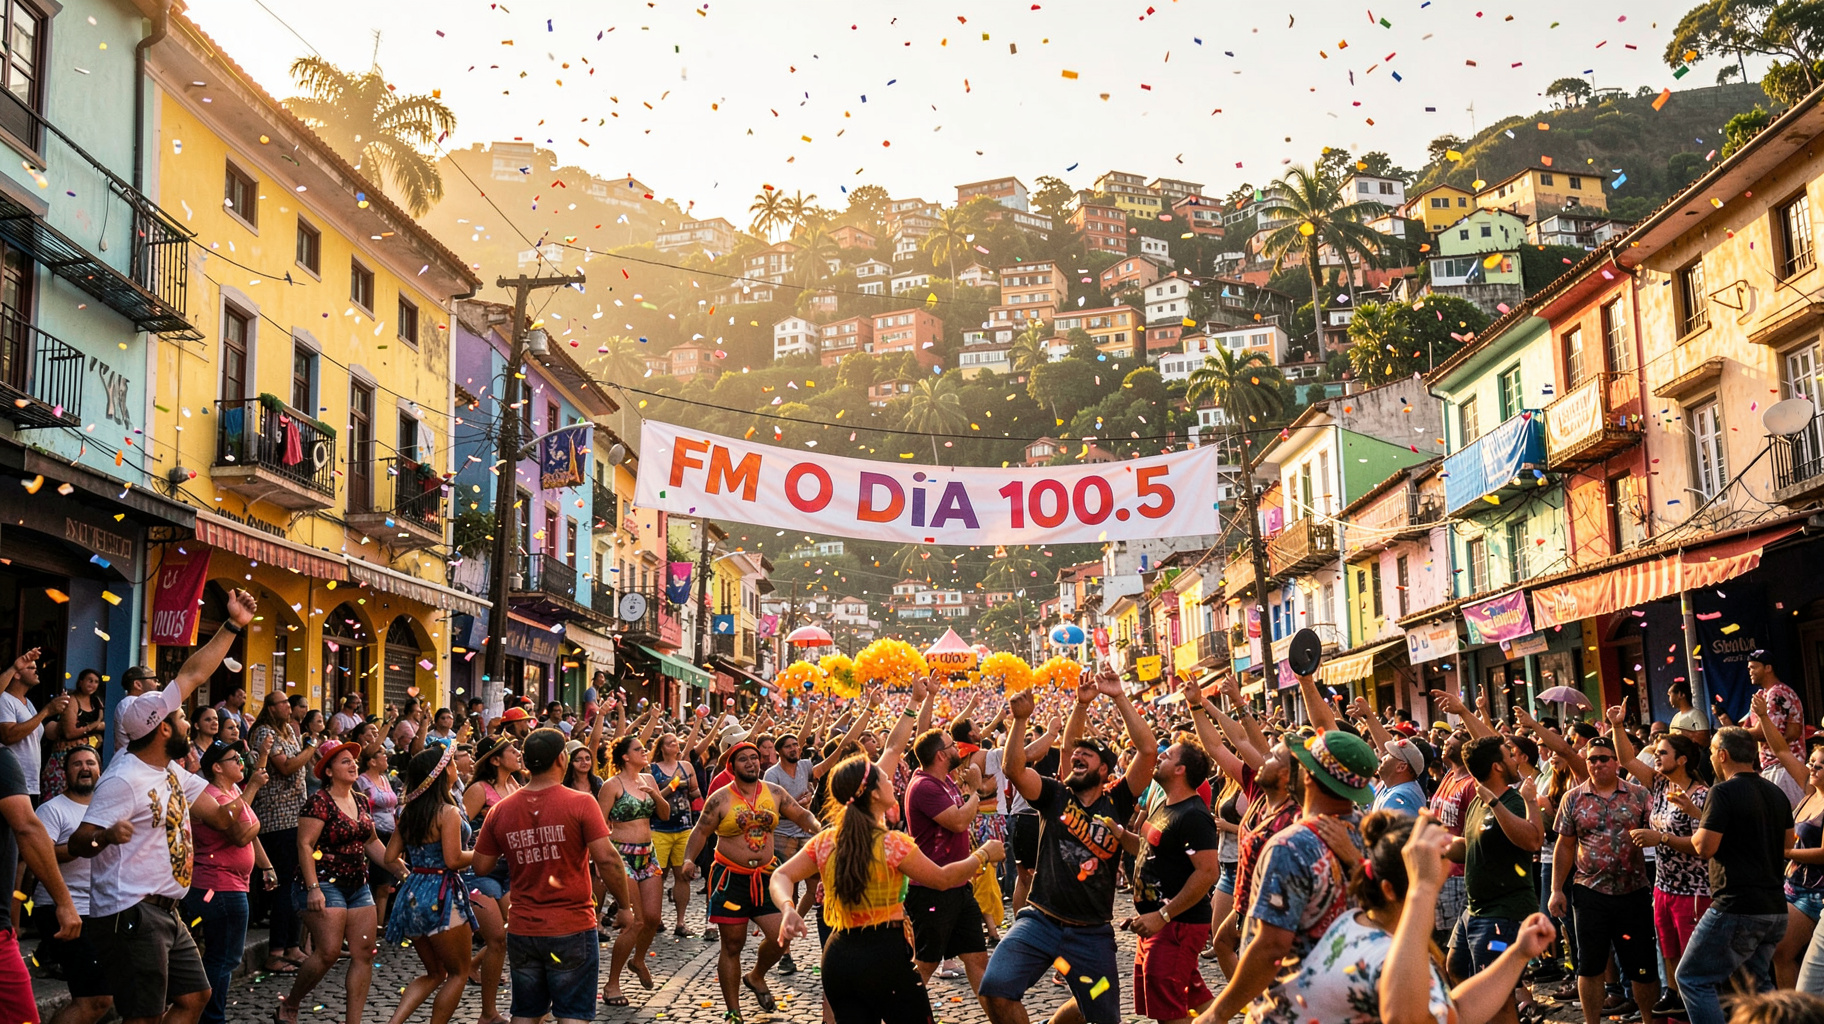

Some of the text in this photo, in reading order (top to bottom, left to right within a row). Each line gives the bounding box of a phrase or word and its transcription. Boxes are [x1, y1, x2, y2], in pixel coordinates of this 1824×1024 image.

[669, 436, 763, 503] FM
[784, 462, 834, 514] O
[998, 464, 1176, 529] 100.5
